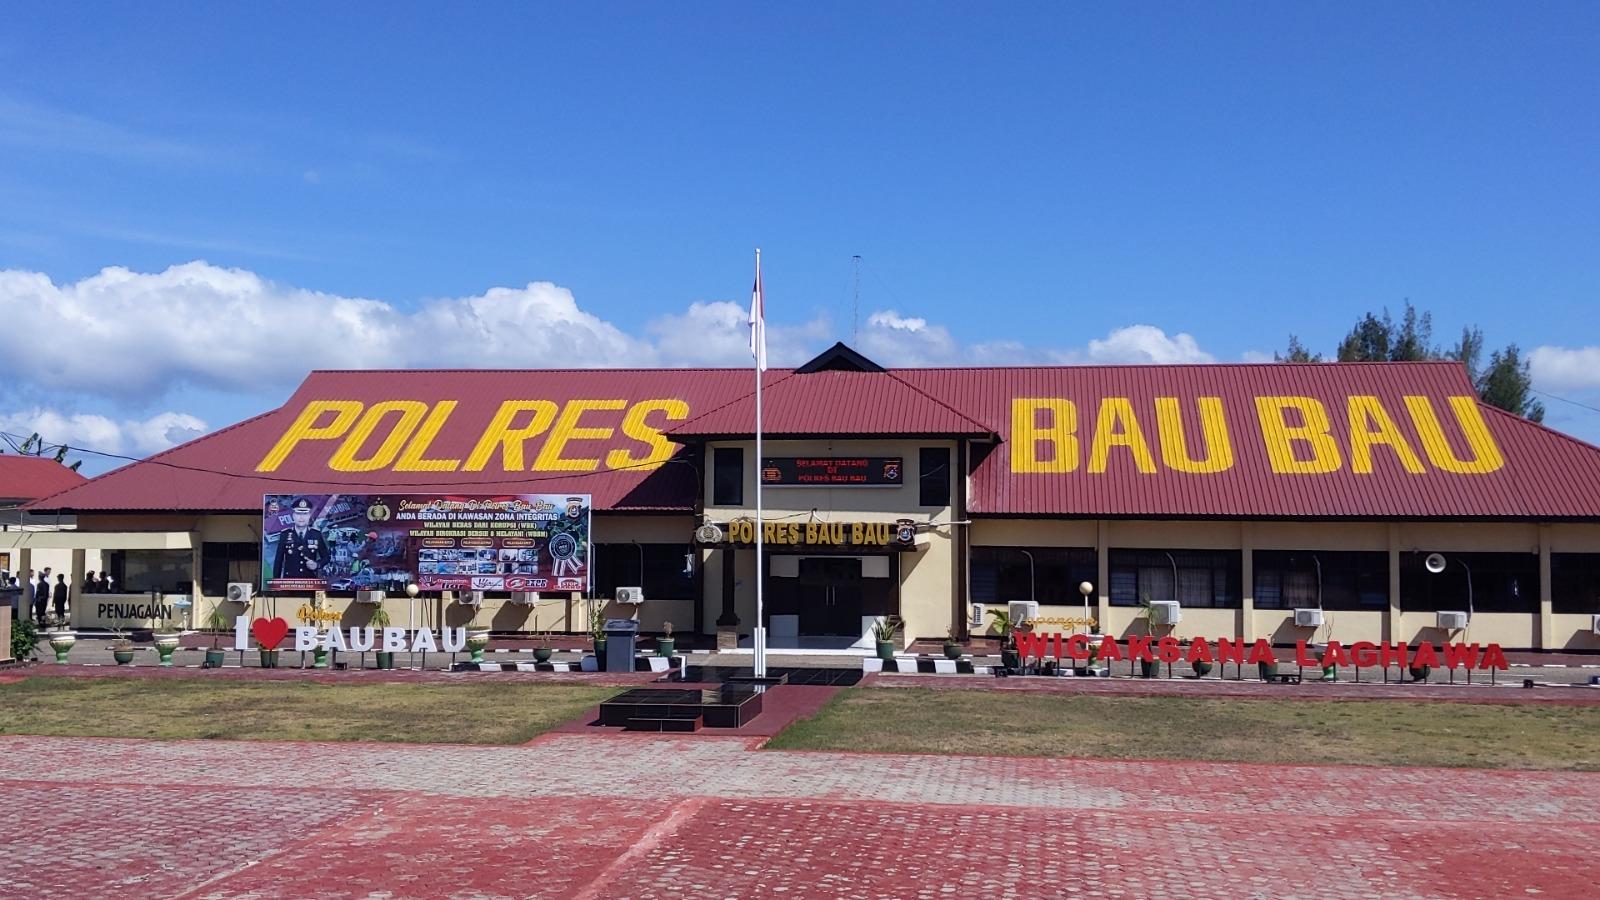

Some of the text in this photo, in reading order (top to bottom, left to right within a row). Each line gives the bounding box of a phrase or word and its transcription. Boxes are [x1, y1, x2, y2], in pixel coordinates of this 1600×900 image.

[255, 396, 1504, 473] POLRES BAU BAU
[396, 512, 416, 520] ANDA
[516, 513, 558, 521] INTEGRITAS
[728, 521, 889, 545] POLRES BAU BAU
[98, 603, 172, 620] PENJAGAAN
[235, 616, 249, 650] I
[1015, 630, 1509, 670] WICAKSANA LAGHAWA
